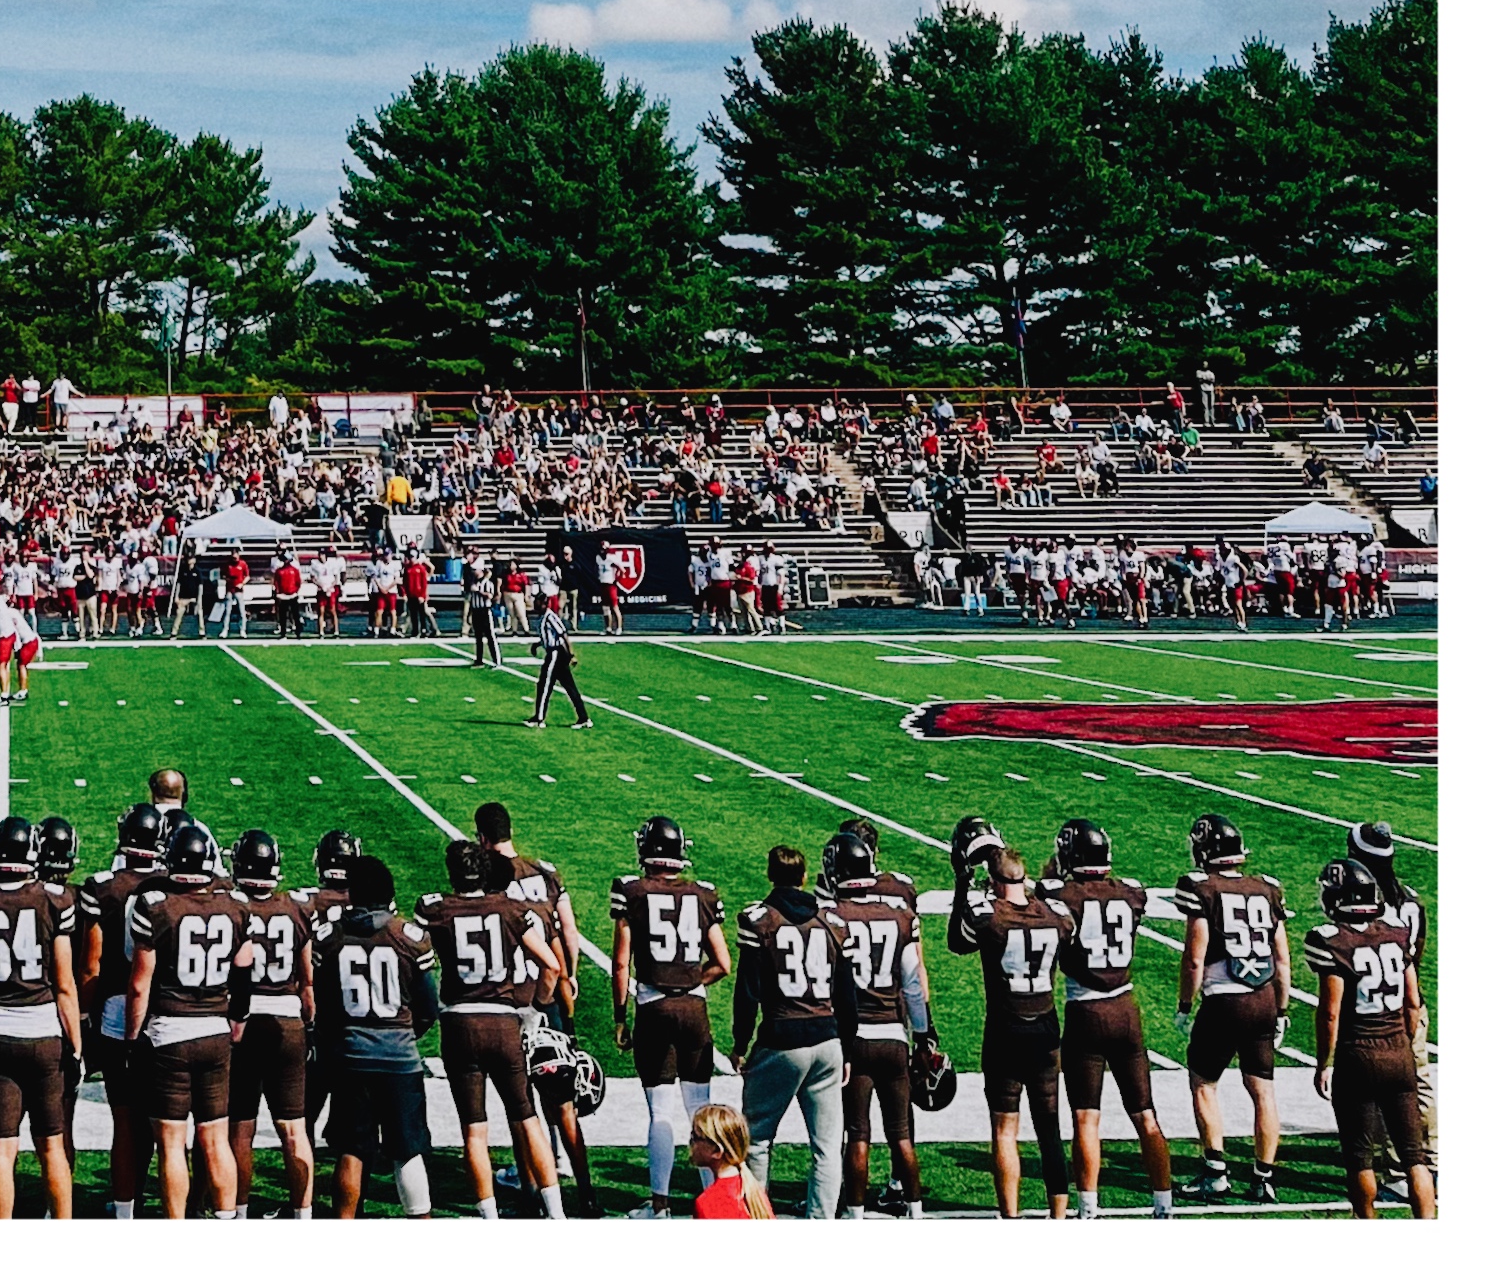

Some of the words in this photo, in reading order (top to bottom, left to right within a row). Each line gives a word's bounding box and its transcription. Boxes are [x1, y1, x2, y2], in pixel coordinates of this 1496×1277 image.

[627, 595, 668, 604] MEDICINE
[177, 913, 234, 987] 62
[453, 913, 508, 984] 51
[647, 894, 702, 963] 54
[848, 920, 898, 988] 37
[1080, 899, 1133, 969] 43
[1220, 892, 1273, 958] 59
[338, 945, 401, 1019] 60
[775, 924, 832, 999] 34
[1002, 928, 1059, 993] 47
[1353, 942, 1405, 1014] 29
